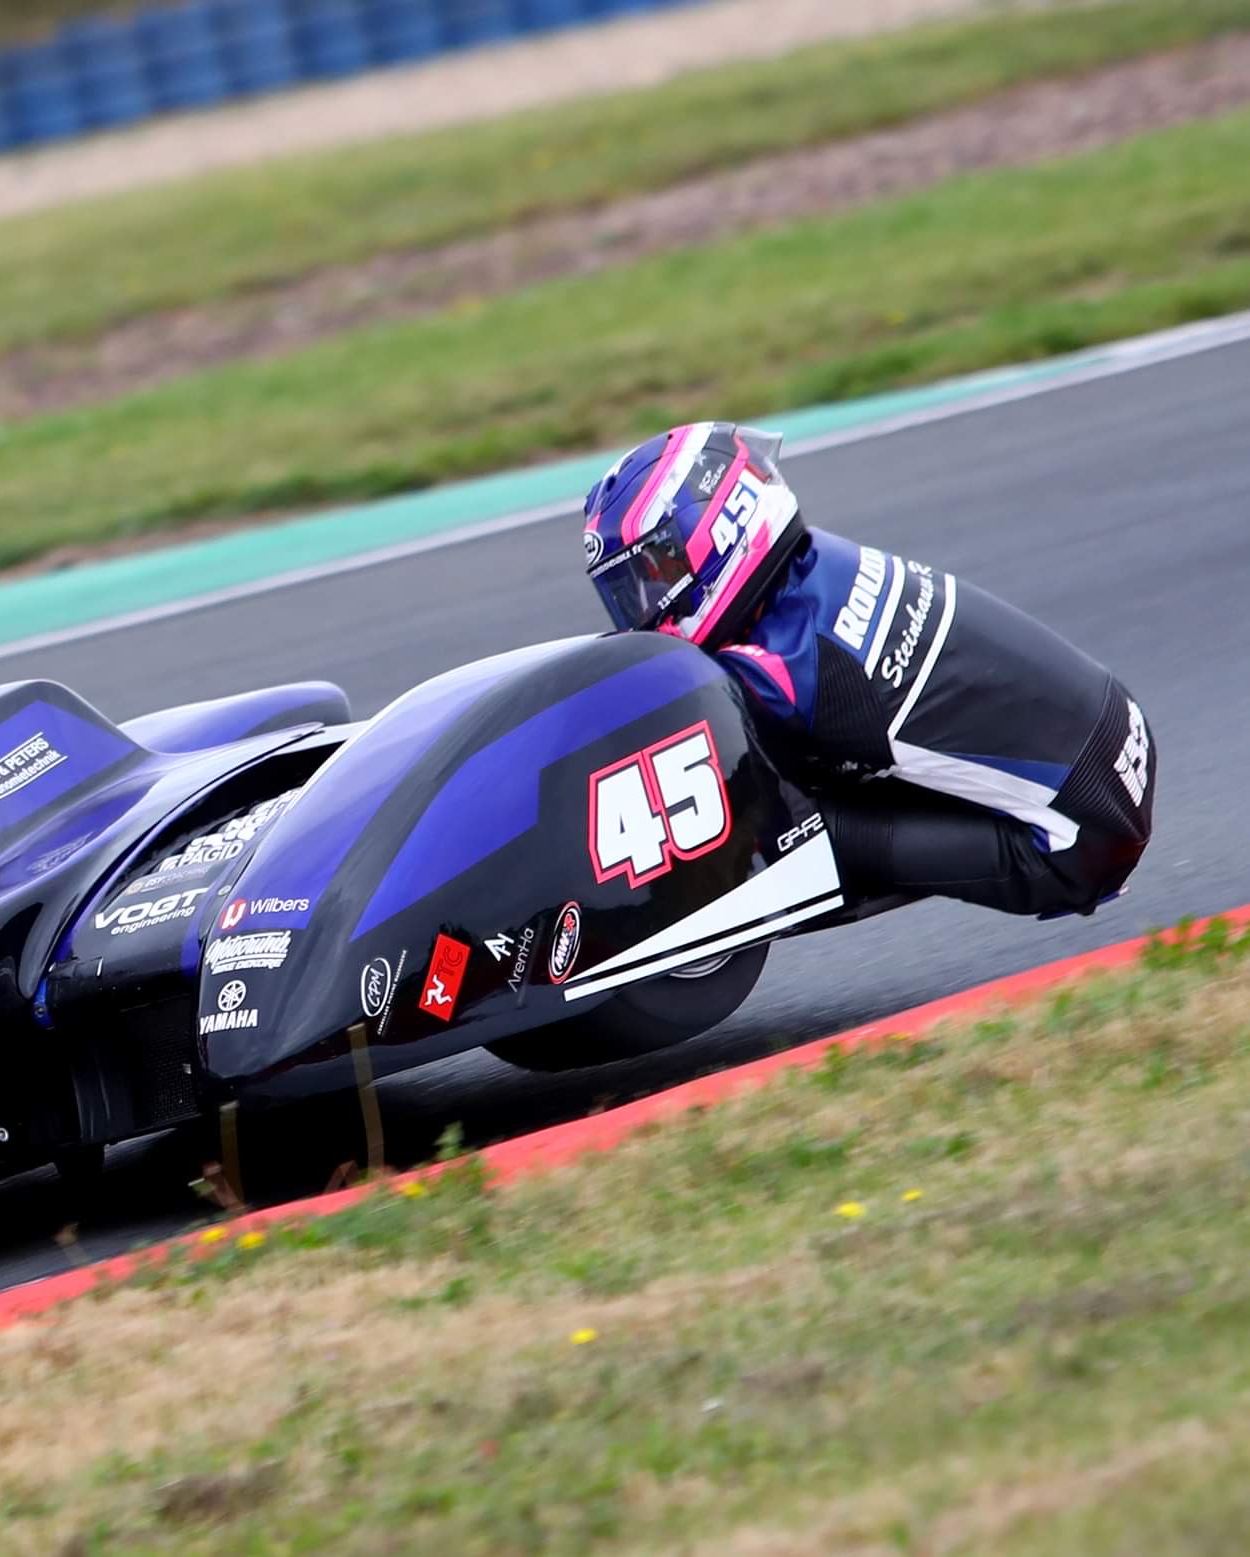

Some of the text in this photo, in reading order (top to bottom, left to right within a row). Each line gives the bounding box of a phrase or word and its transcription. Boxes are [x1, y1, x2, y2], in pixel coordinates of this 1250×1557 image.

[8, 737, 50, 771] PETERS
[587, 719, 732, 889] 45
[178, 839, 244, 867] PAGID
[94, 887, 212, 930] VOGT
[111, 905, 195, 936] engineering
[250, 897, 309, 915] Wilbers
[199, 1009, 258, 1035] YAMAHA
